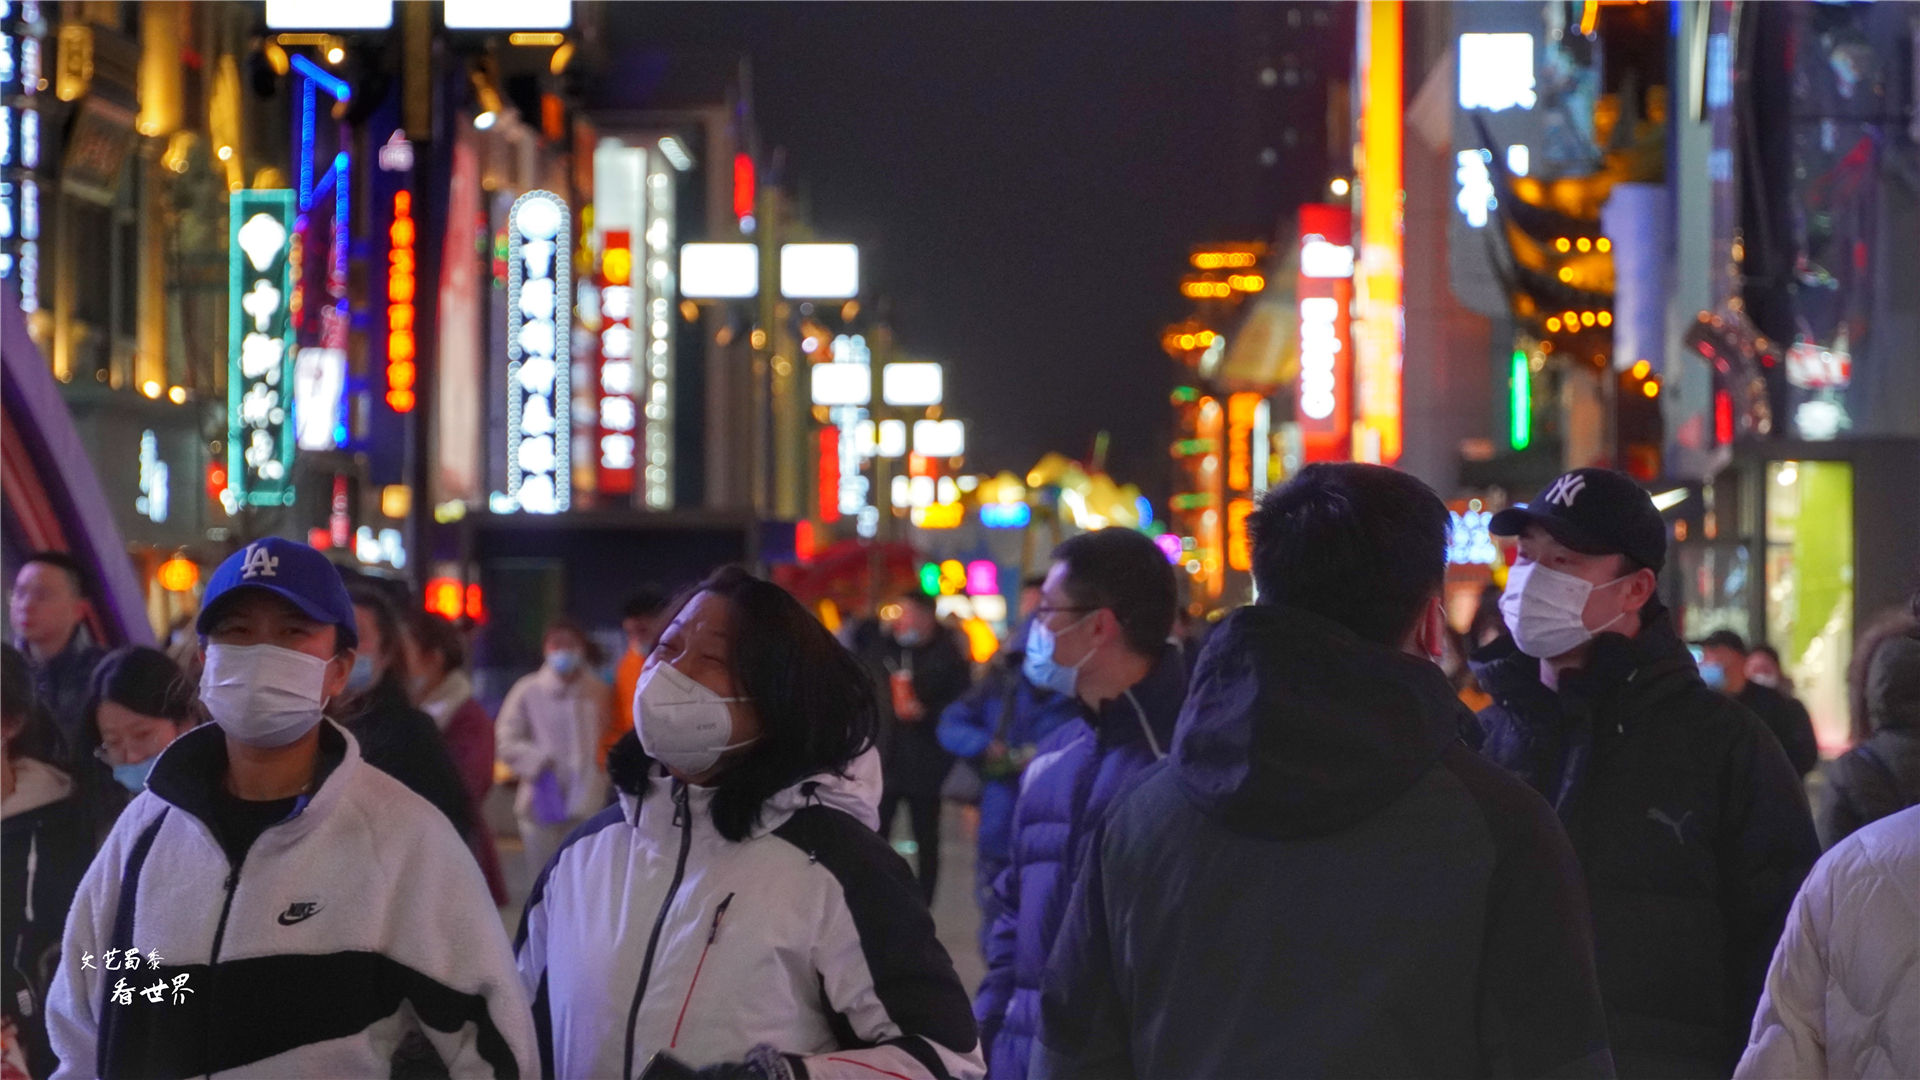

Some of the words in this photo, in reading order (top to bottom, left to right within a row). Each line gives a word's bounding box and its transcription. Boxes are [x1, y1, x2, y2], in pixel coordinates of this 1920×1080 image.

[1545, 473, 1586, 508] NY
[240, 543, 280, 579] LA
[286, 902, 317, 917] NIKE
